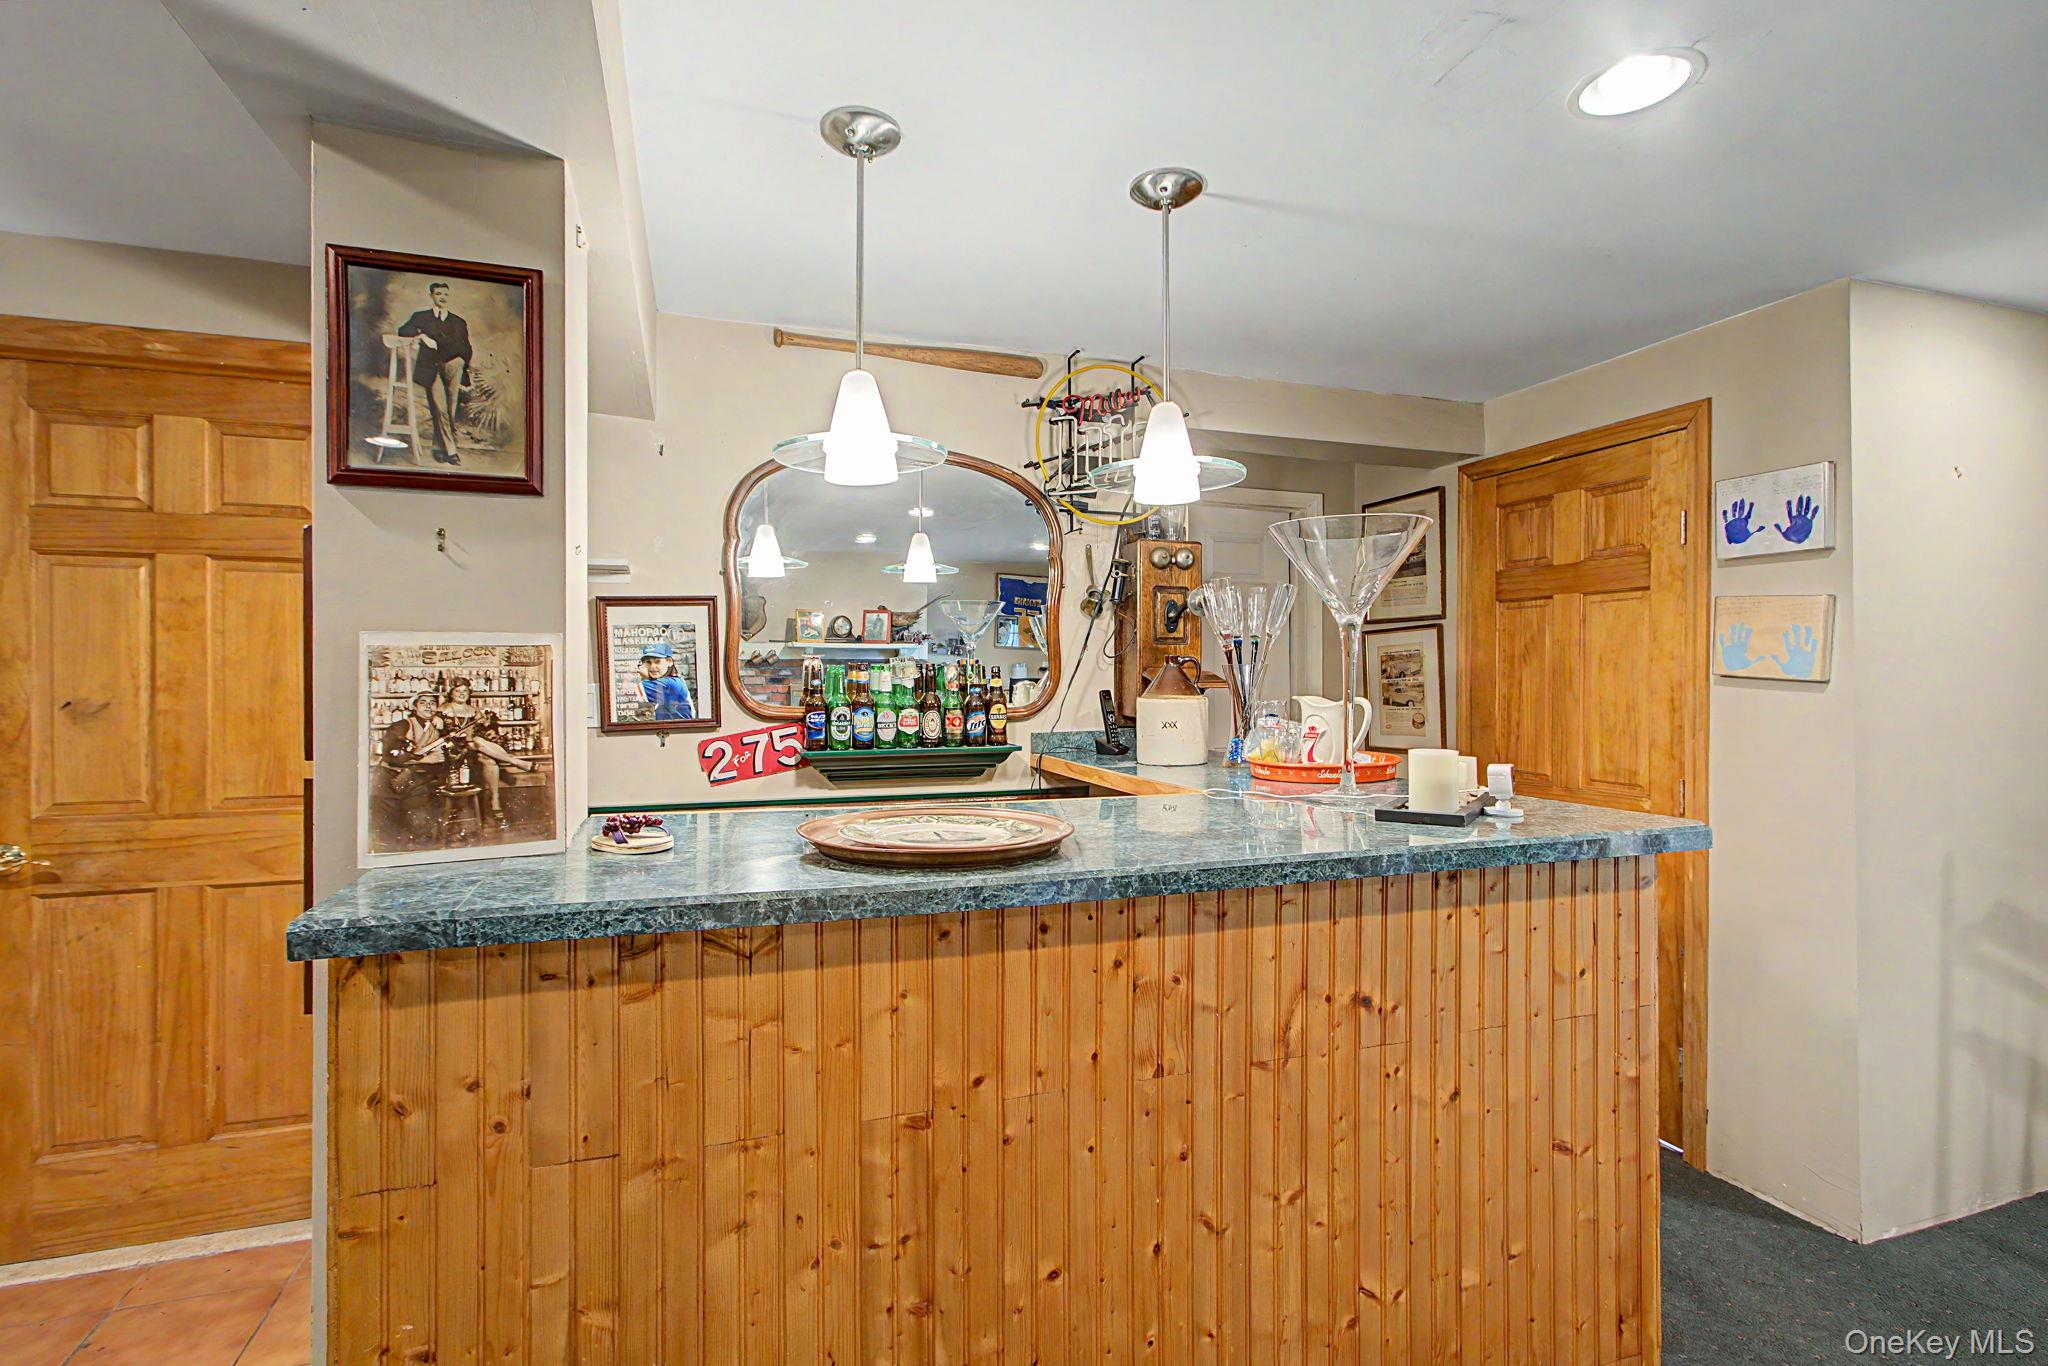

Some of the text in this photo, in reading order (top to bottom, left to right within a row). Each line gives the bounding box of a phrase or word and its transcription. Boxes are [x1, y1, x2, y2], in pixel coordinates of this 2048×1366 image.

[1062, 388, 1142, 426] Miller
[1161, 720, 1178, 729] XXX
[703, 740, 738, 782] 2
[741, 726, 804, 774] 75
[1302, 732, 1322, 764] 7
